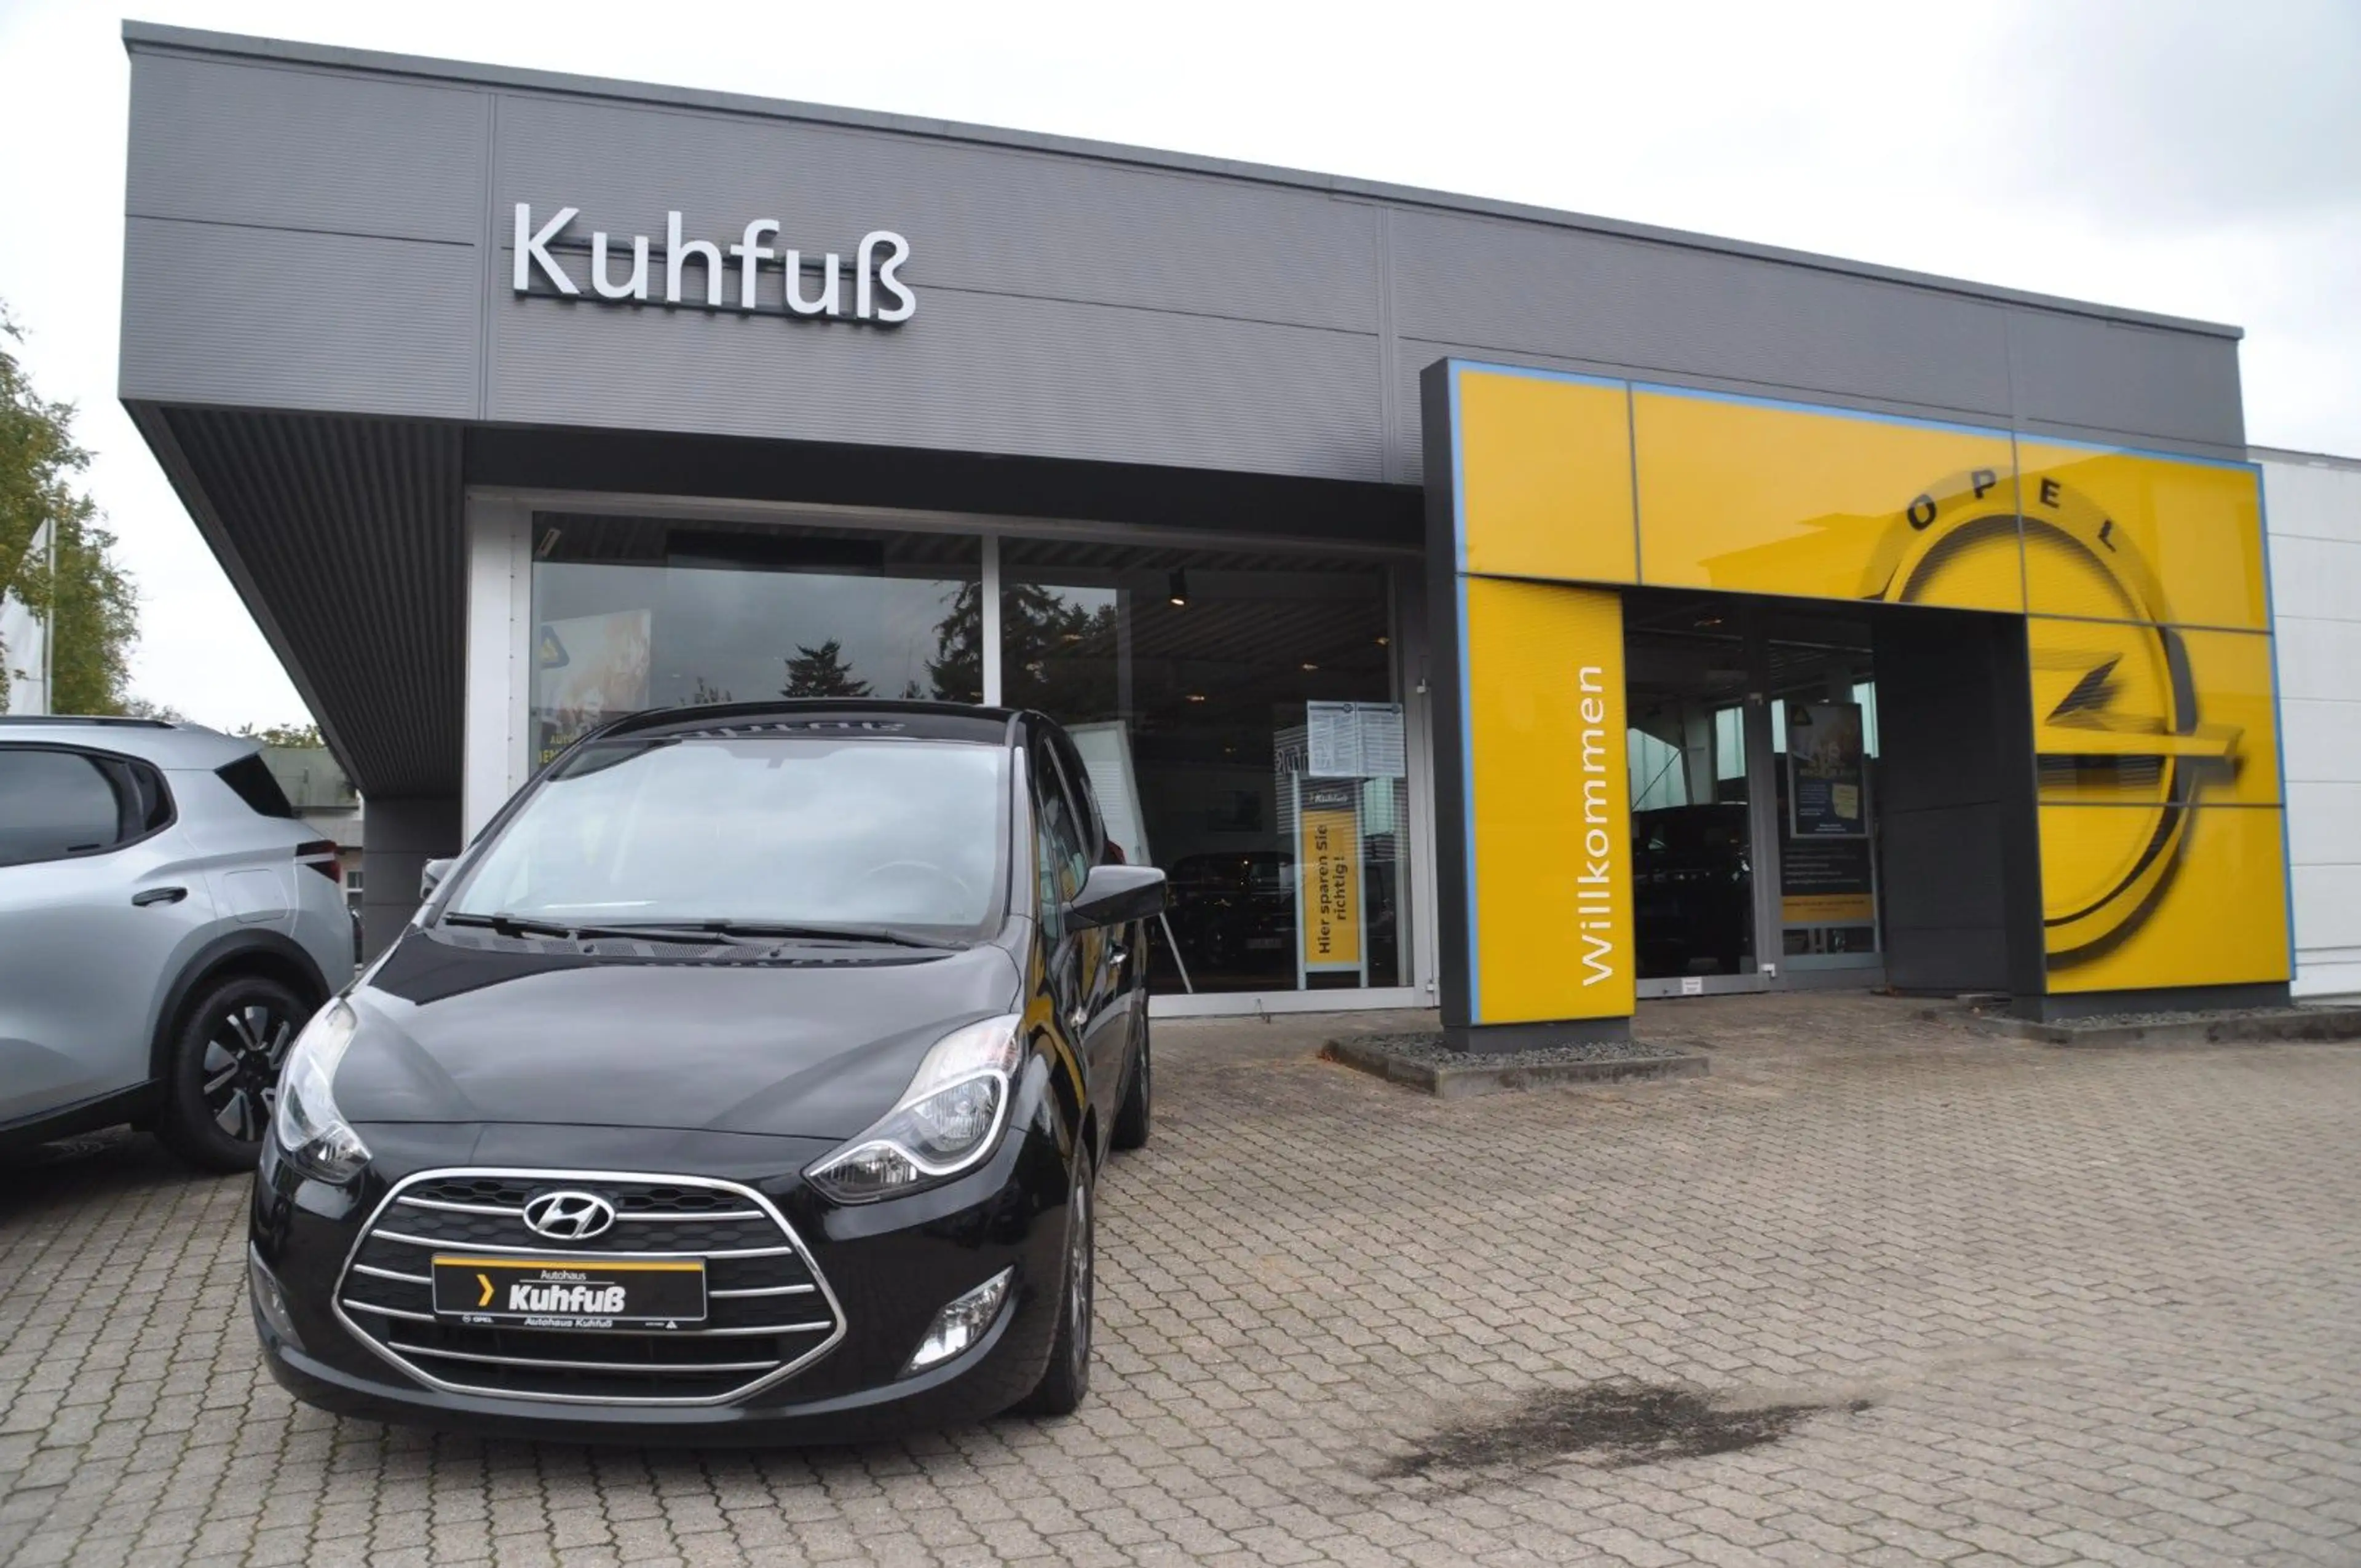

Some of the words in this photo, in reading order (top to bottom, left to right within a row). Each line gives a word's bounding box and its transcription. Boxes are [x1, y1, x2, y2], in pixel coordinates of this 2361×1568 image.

[513, 202, 917, 323] Kuhfuß
[1906, 470, 2116, 553] OPEL
[1315, 824, 1329, 851] Sie
[1318, 856, 1332, 913] sparen
[1318, 919, 1331, 954] Hier
[540, 1270, 587, 1281] Autohaus
[508, 1283, 627, 1313] Kuhfuß
[524, 1317, 573, 1328] Autohaus
